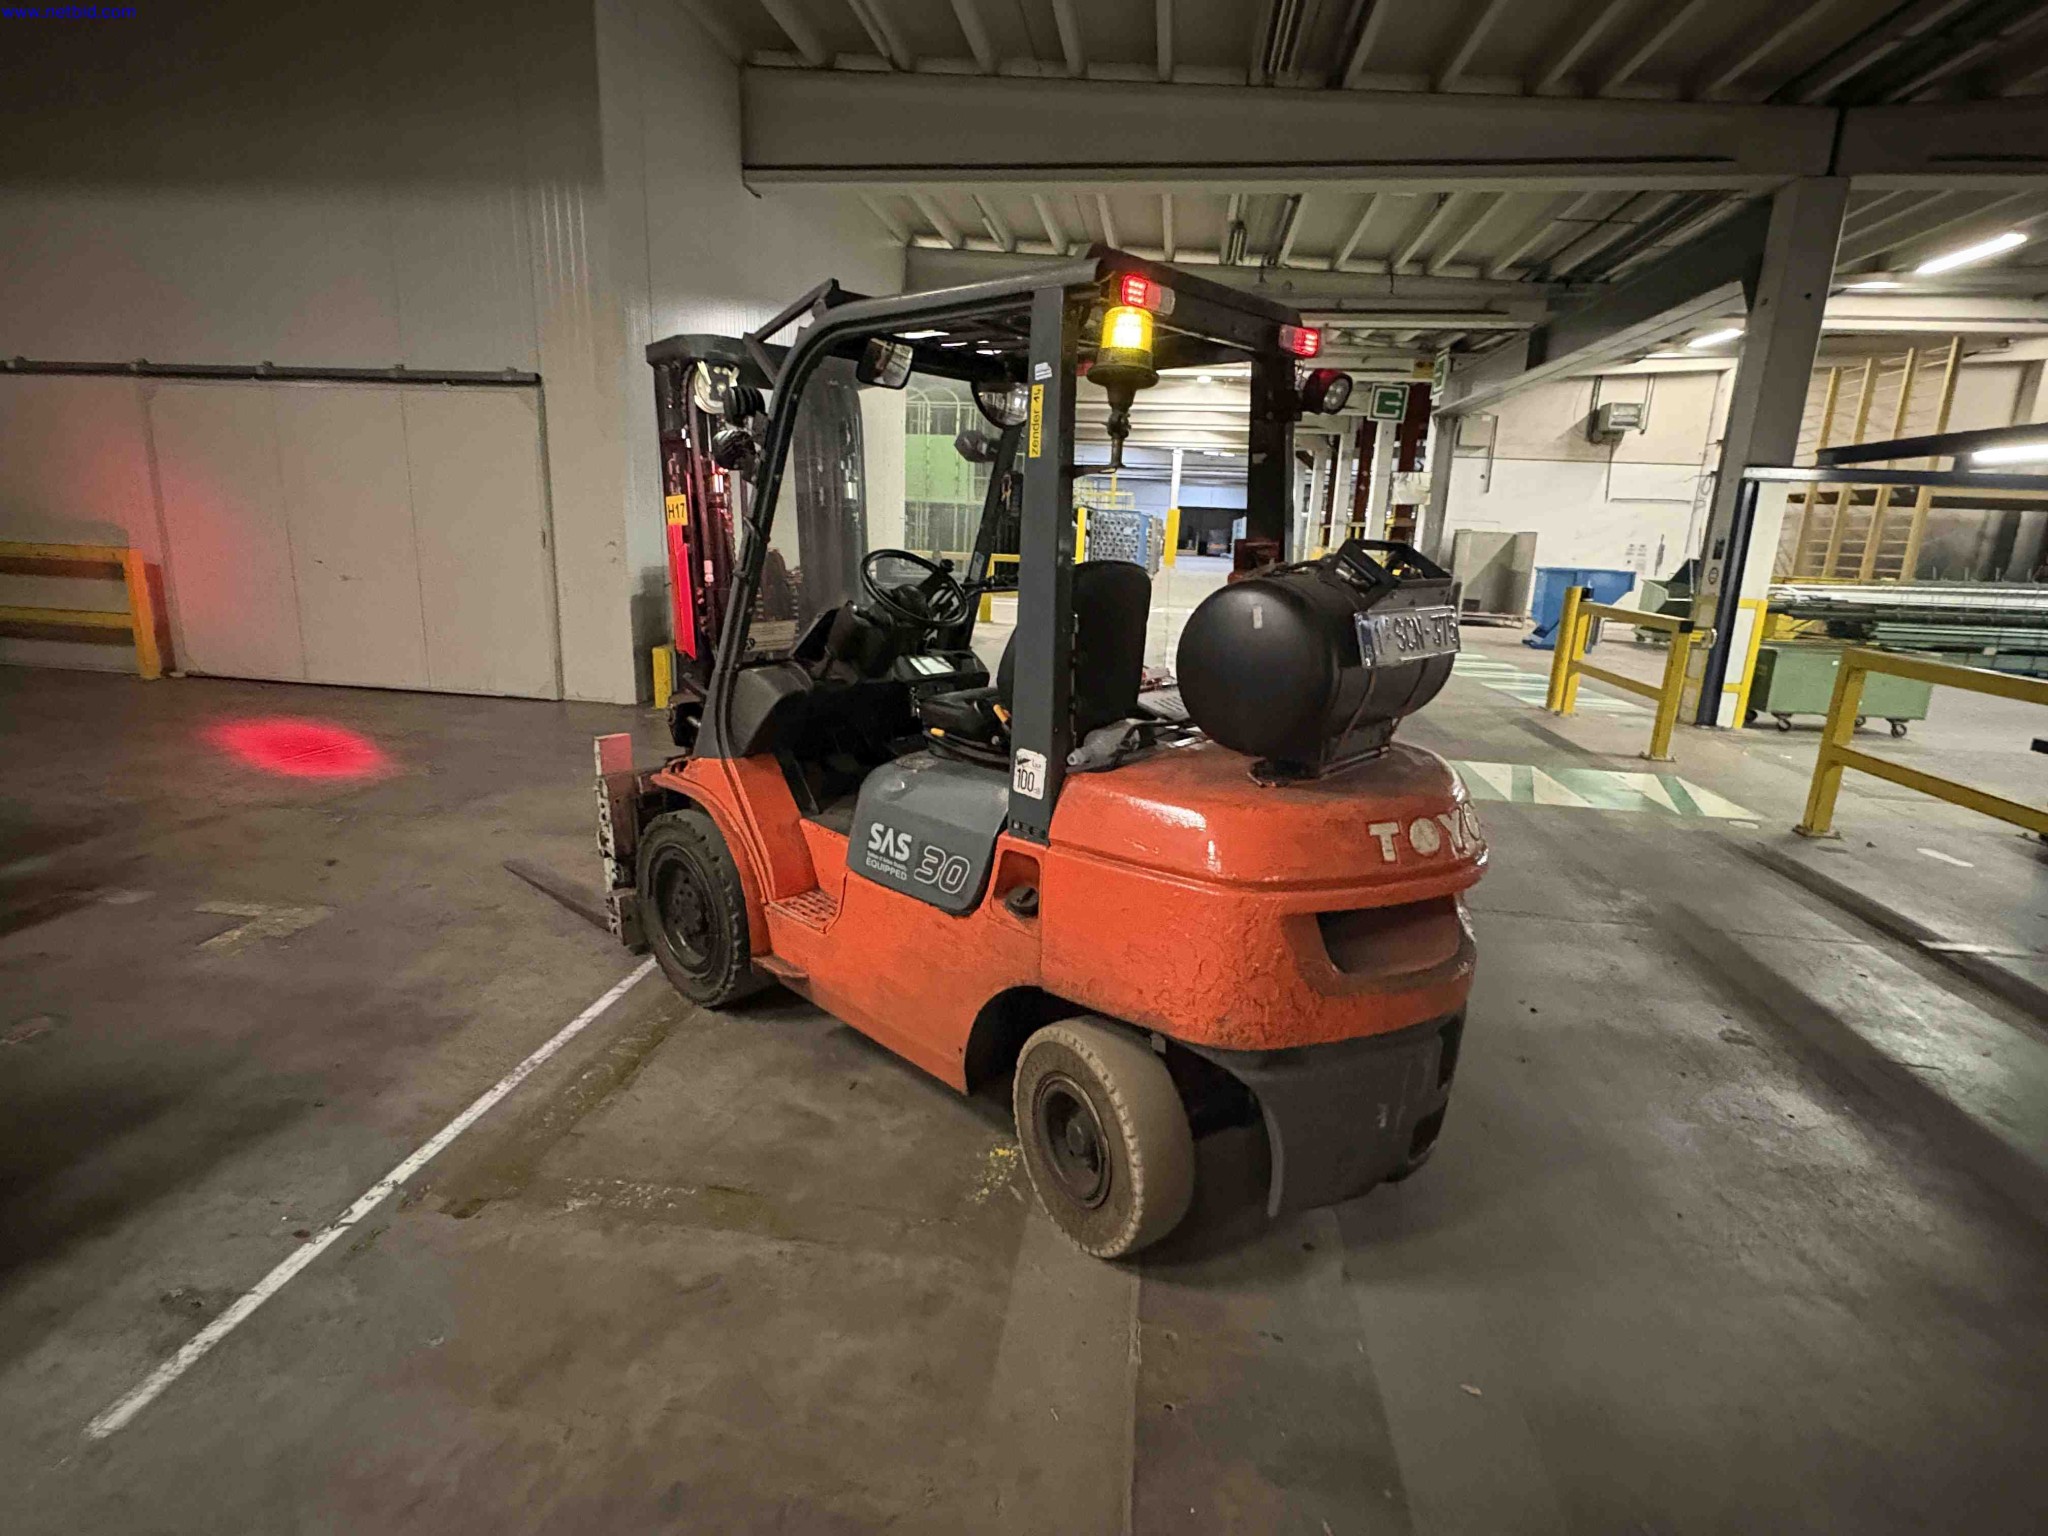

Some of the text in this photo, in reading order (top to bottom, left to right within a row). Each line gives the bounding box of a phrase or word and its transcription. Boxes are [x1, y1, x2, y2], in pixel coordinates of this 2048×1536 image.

[667, 502, 685, 519] H17
[1017, 768, 1035, 792] 100
[866, 856, 908, 882] EQUIPPED
[868, 822, 913, 862] SAS
[913, 844, 971, 895] 30
